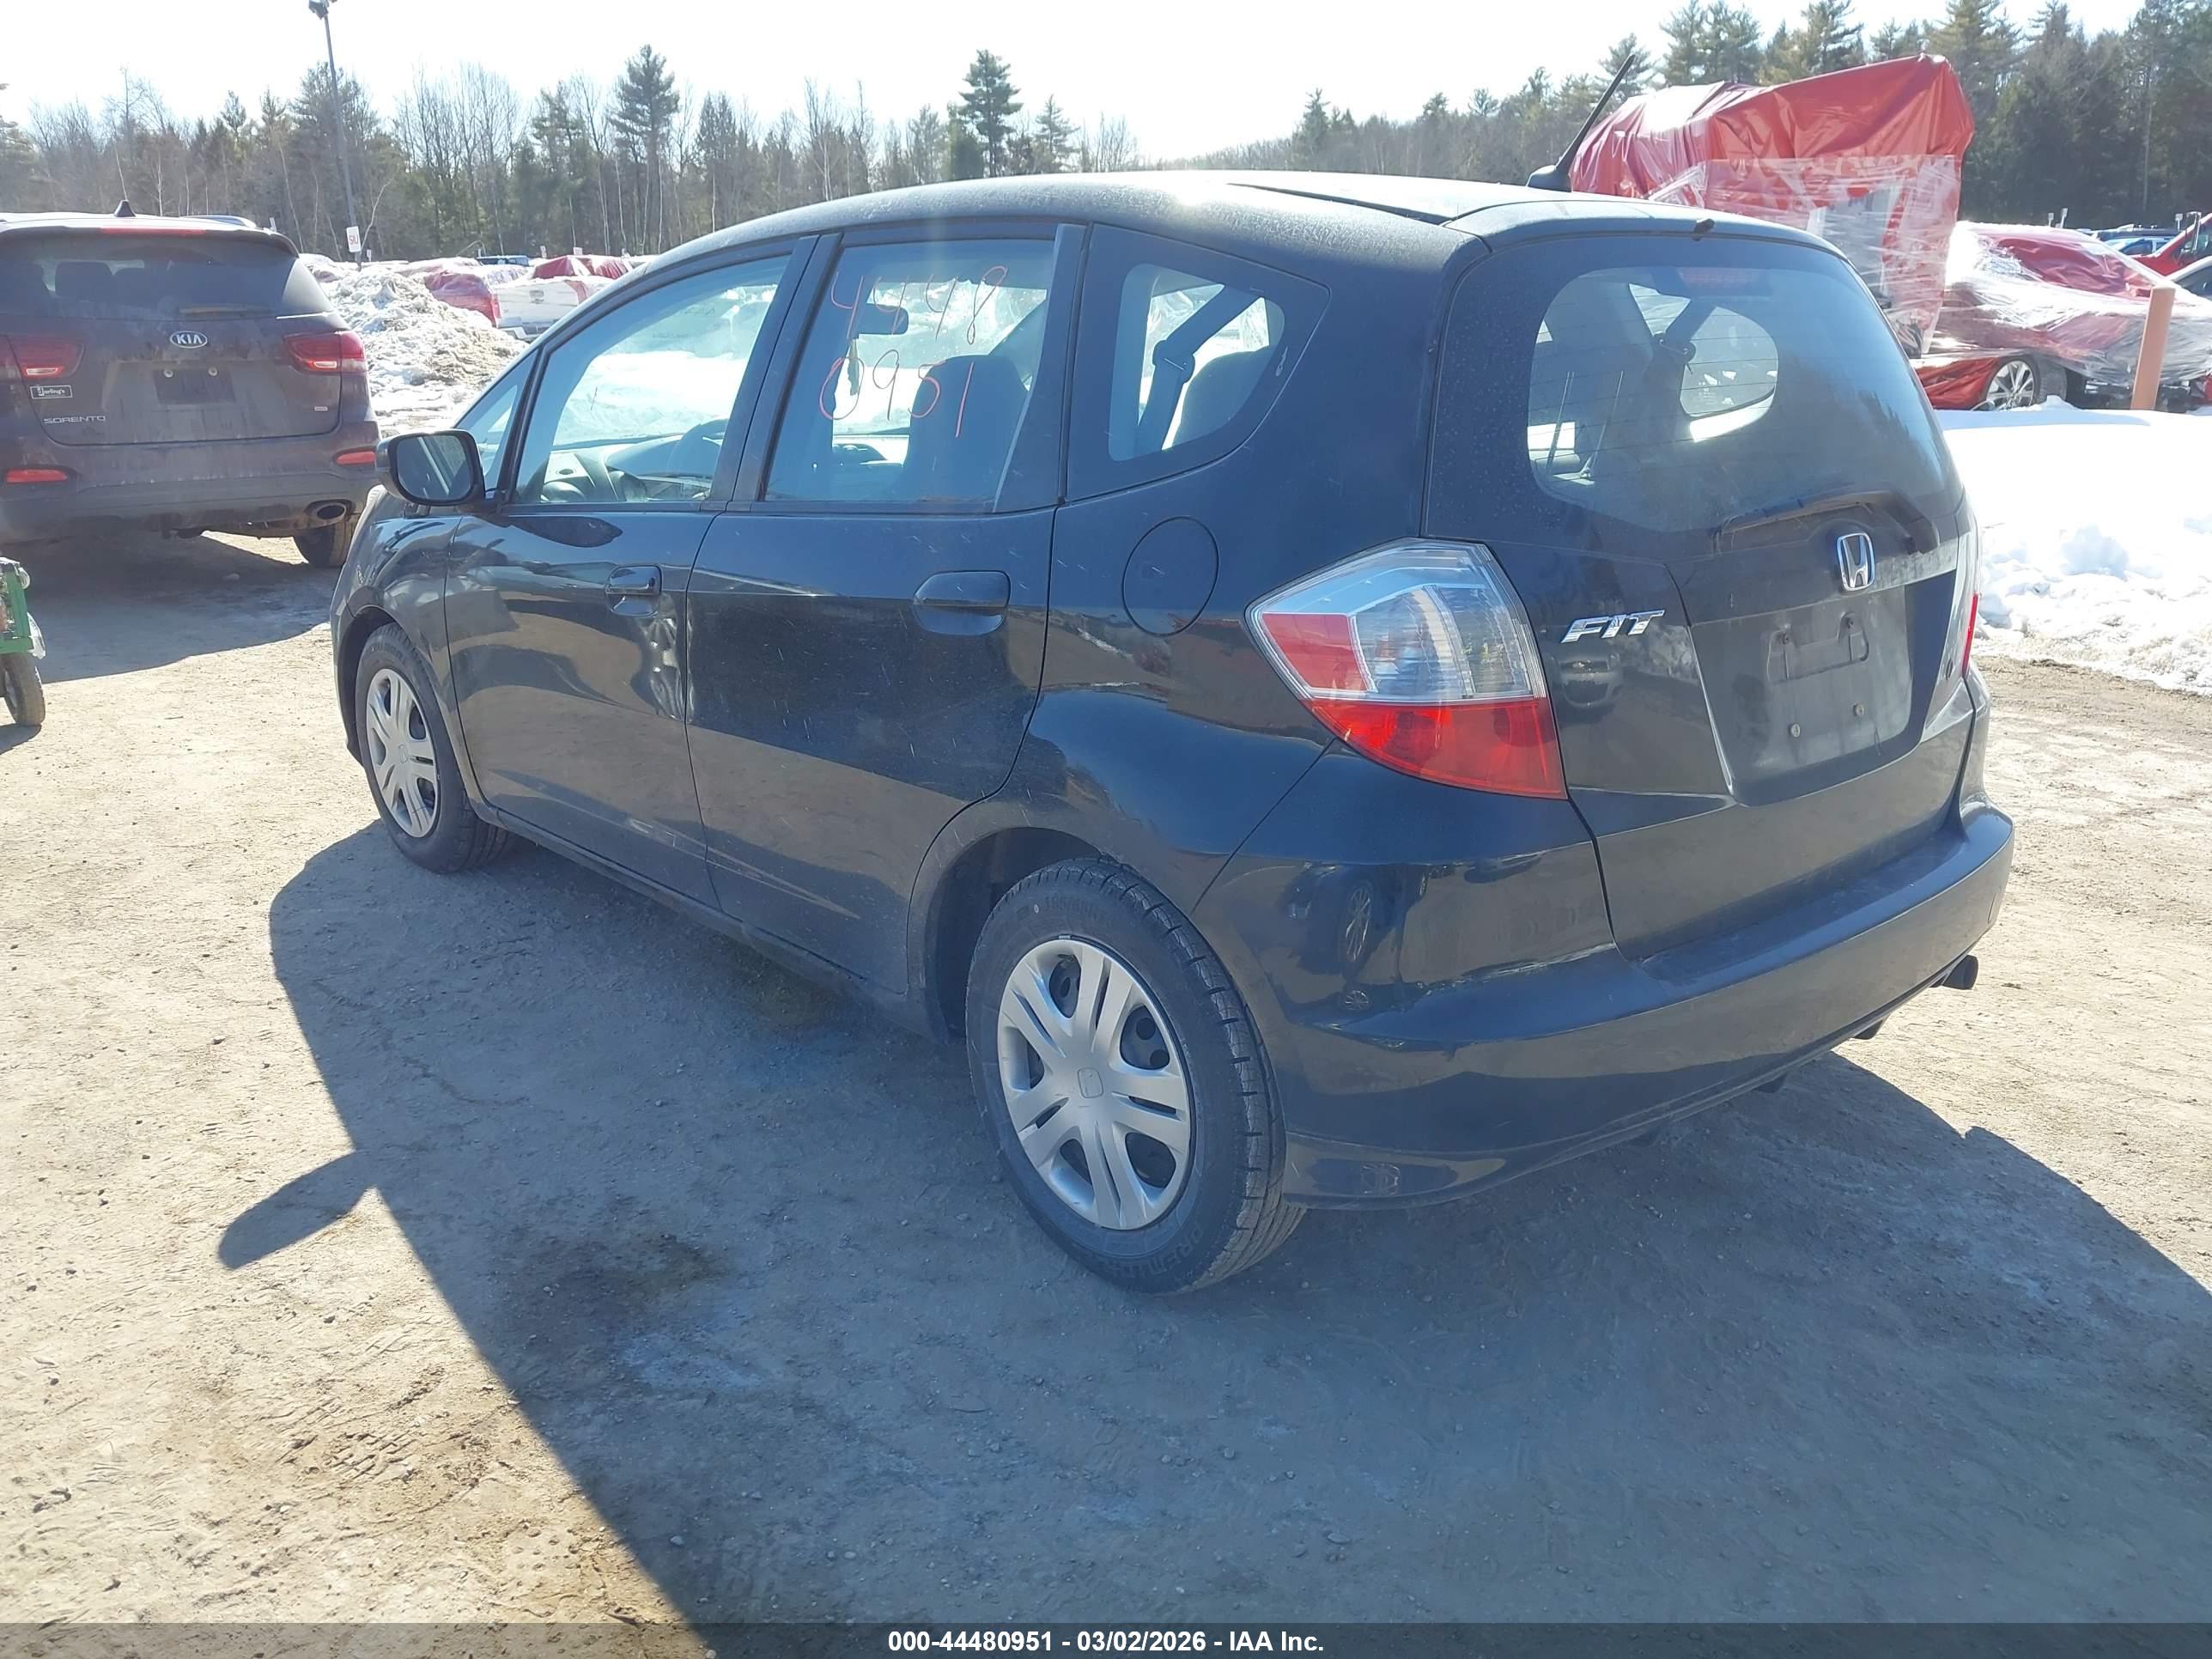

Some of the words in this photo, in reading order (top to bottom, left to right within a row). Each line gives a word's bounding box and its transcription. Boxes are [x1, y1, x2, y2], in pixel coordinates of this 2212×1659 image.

[818, 348, 975, 439] 0951
[43, 416, 106, 424] SORENTO
[1560, 610, 1666, 644] FIT
